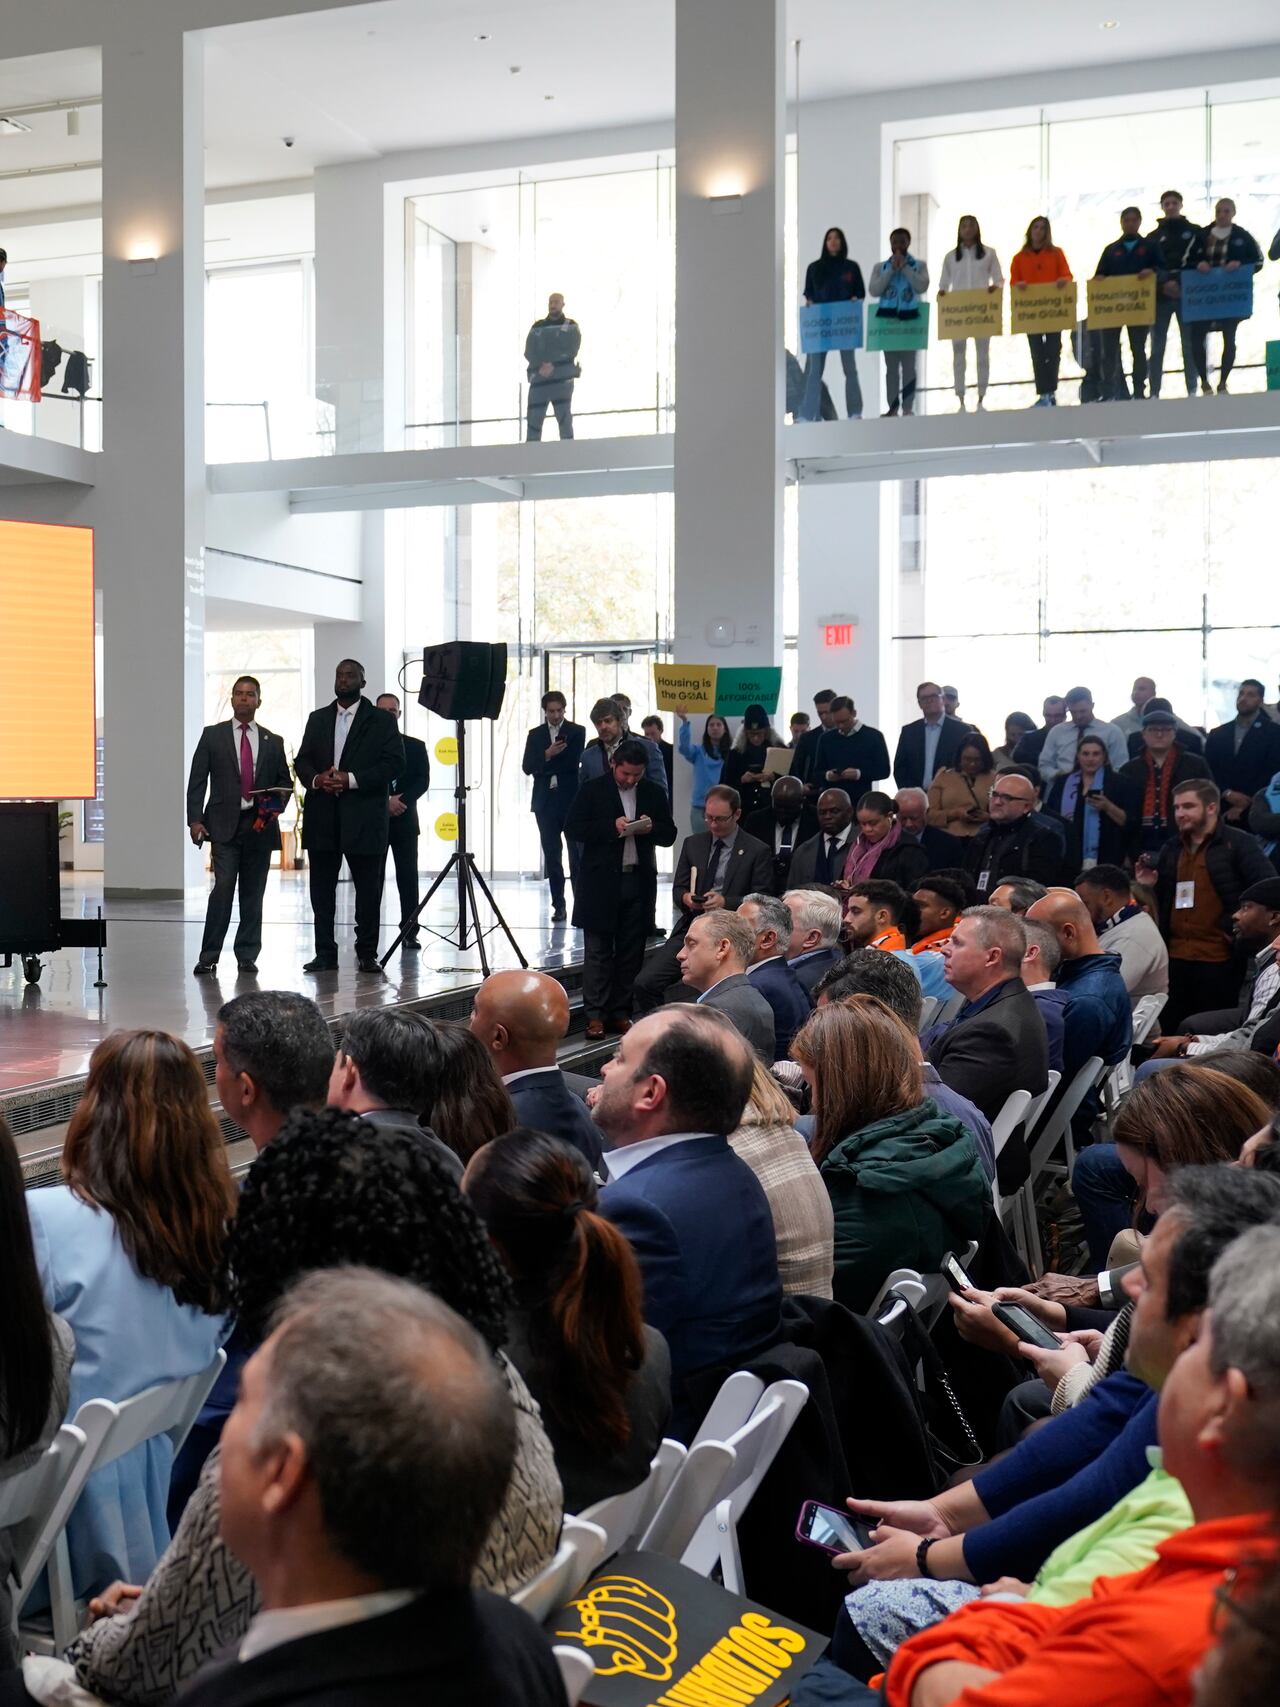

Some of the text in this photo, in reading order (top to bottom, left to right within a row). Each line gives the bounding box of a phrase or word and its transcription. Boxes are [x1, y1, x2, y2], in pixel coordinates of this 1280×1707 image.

[1091, 287, 1150, 302] Housing is
[1015, 295, 1073, 308] Housing is
[941, 302, 998, 314] Housing is
[1095, 305, 1113, 315] the
[1018, 311, 1036, 321] the
[945, 318, 962, 327] the
[825, 624, 852, 646] EXIT
[658, 677, 711, 690] Housing is
[738, 682, 761, 691] 100%
[661, 690, 708, 701] the GOAL
